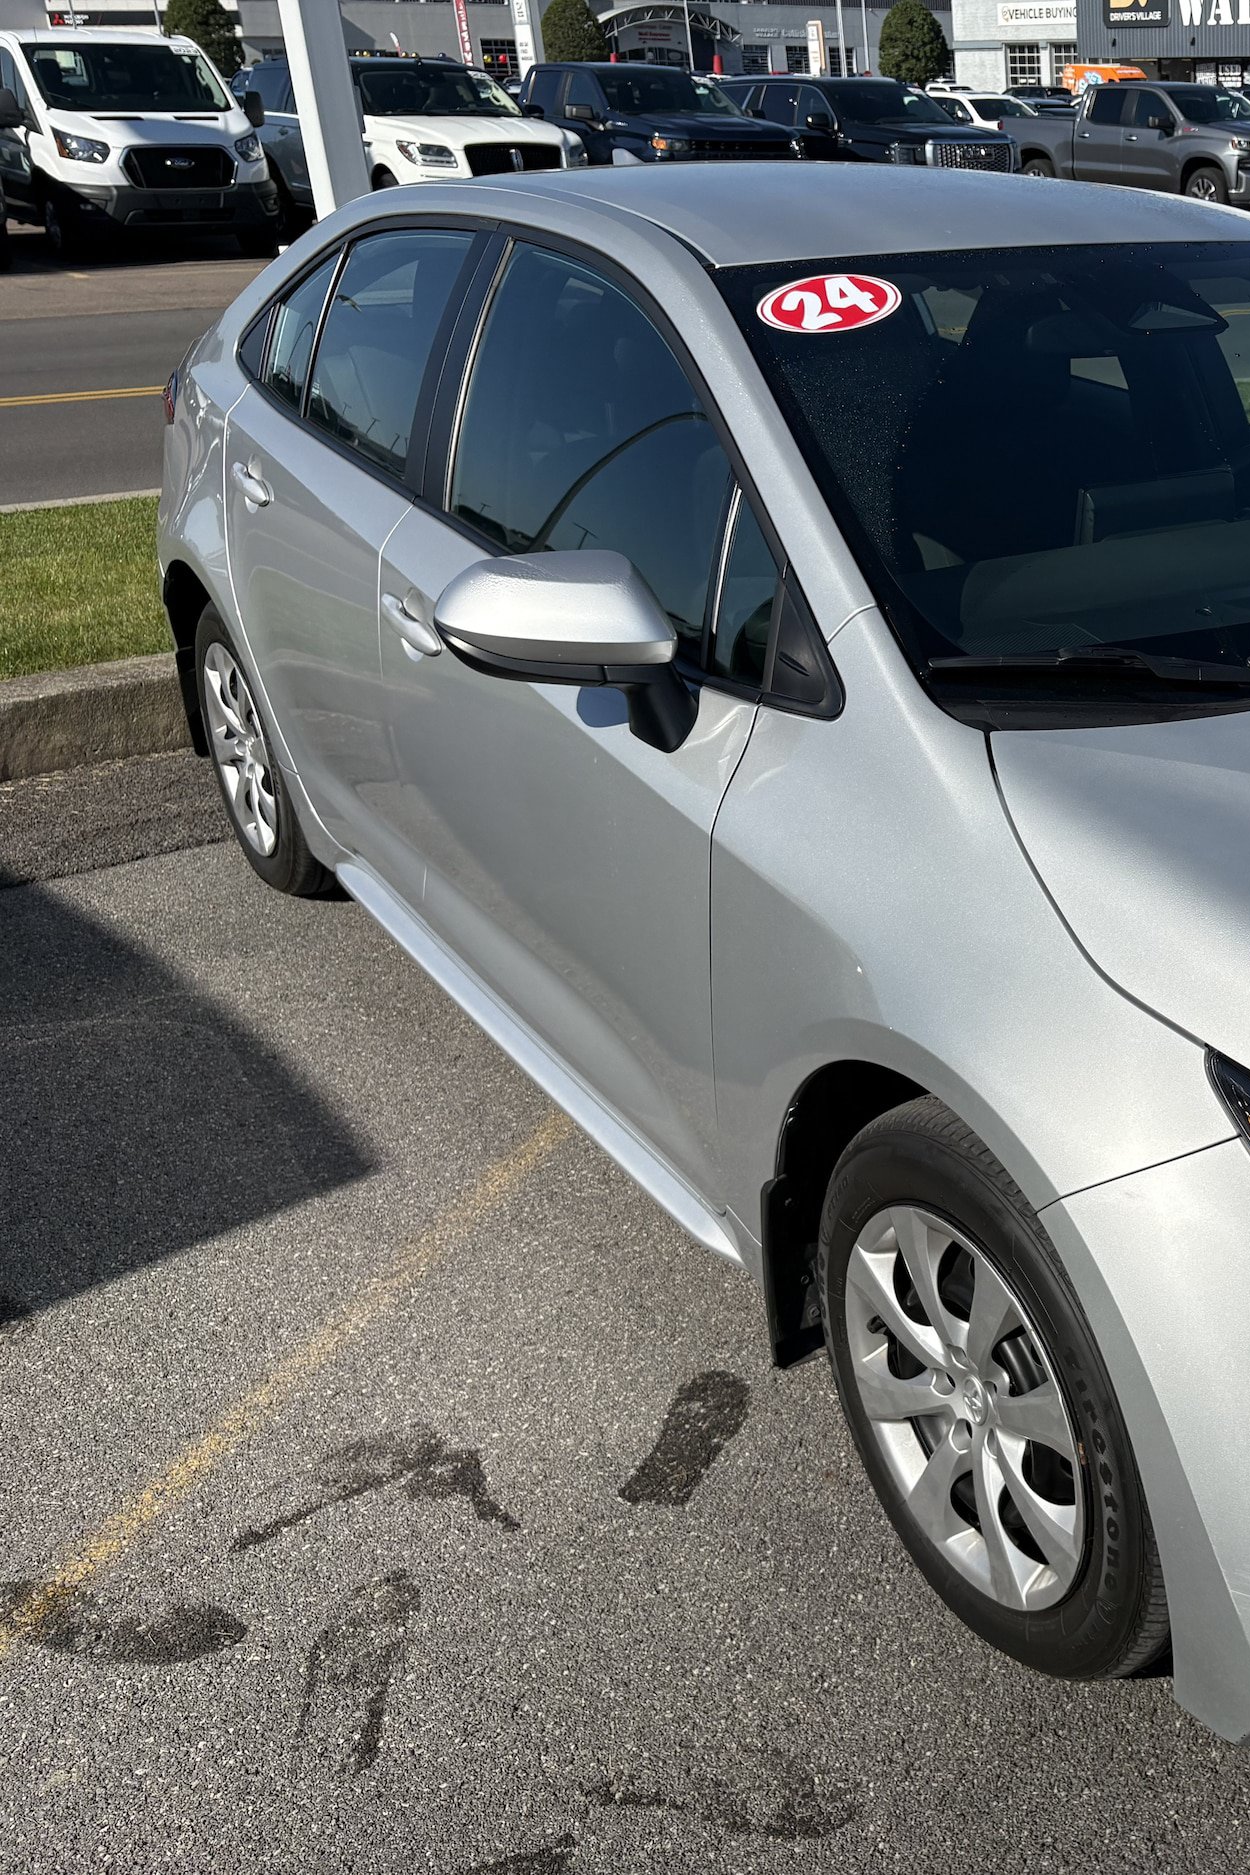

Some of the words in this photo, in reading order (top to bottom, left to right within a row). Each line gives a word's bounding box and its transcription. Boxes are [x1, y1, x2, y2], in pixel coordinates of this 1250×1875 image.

[1009, 8, 1044, 20] VEHICLE
[1136, 10, 1162, 20] VILLAGE
[781, 276, 880, 330] 24
[1062, 1345, 1122, 1595] Firestone
